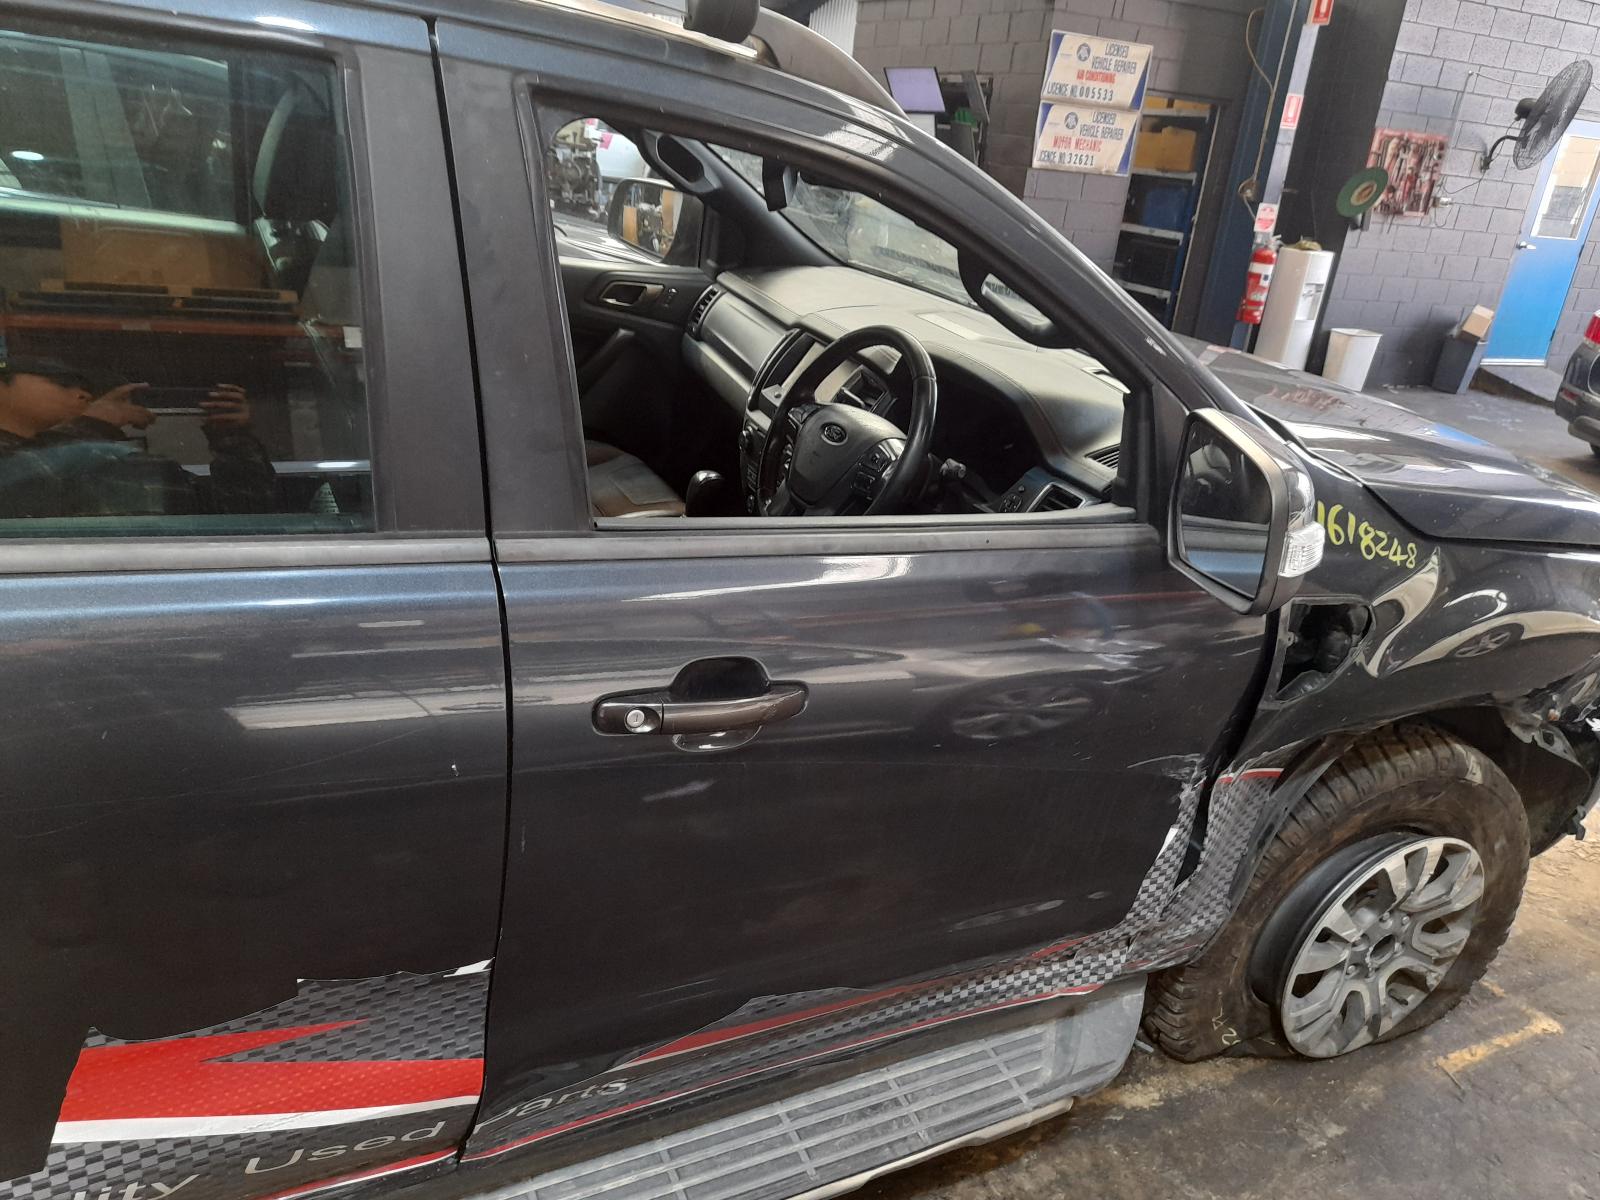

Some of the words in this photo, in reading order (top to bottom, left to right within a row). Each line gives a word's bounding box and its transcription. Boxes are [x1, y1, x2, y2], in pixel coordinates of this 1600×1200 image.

[1105, 42, 1129, 58] LICENSED
[1092, 56, 1112, 71] VEHICLE
[1113, 60, 1137, 75] REPAIRER
[1076, 69, 1085, 80] AIR
[1093, 111, 1117, 126] LICENSED
[1079, 123, 1100, 138] VEHICLE
[1101, 127, 1125, 141] REPAIRER
[1053, 135, 1072, 150] MOTOR
[1075, 138, 1103, 152] MECHANIC
[1067, 152, 1094, 167] 32621
[1317, 500, 1418, 569] 1618248
[245, 1120, 446, 1175] Used
